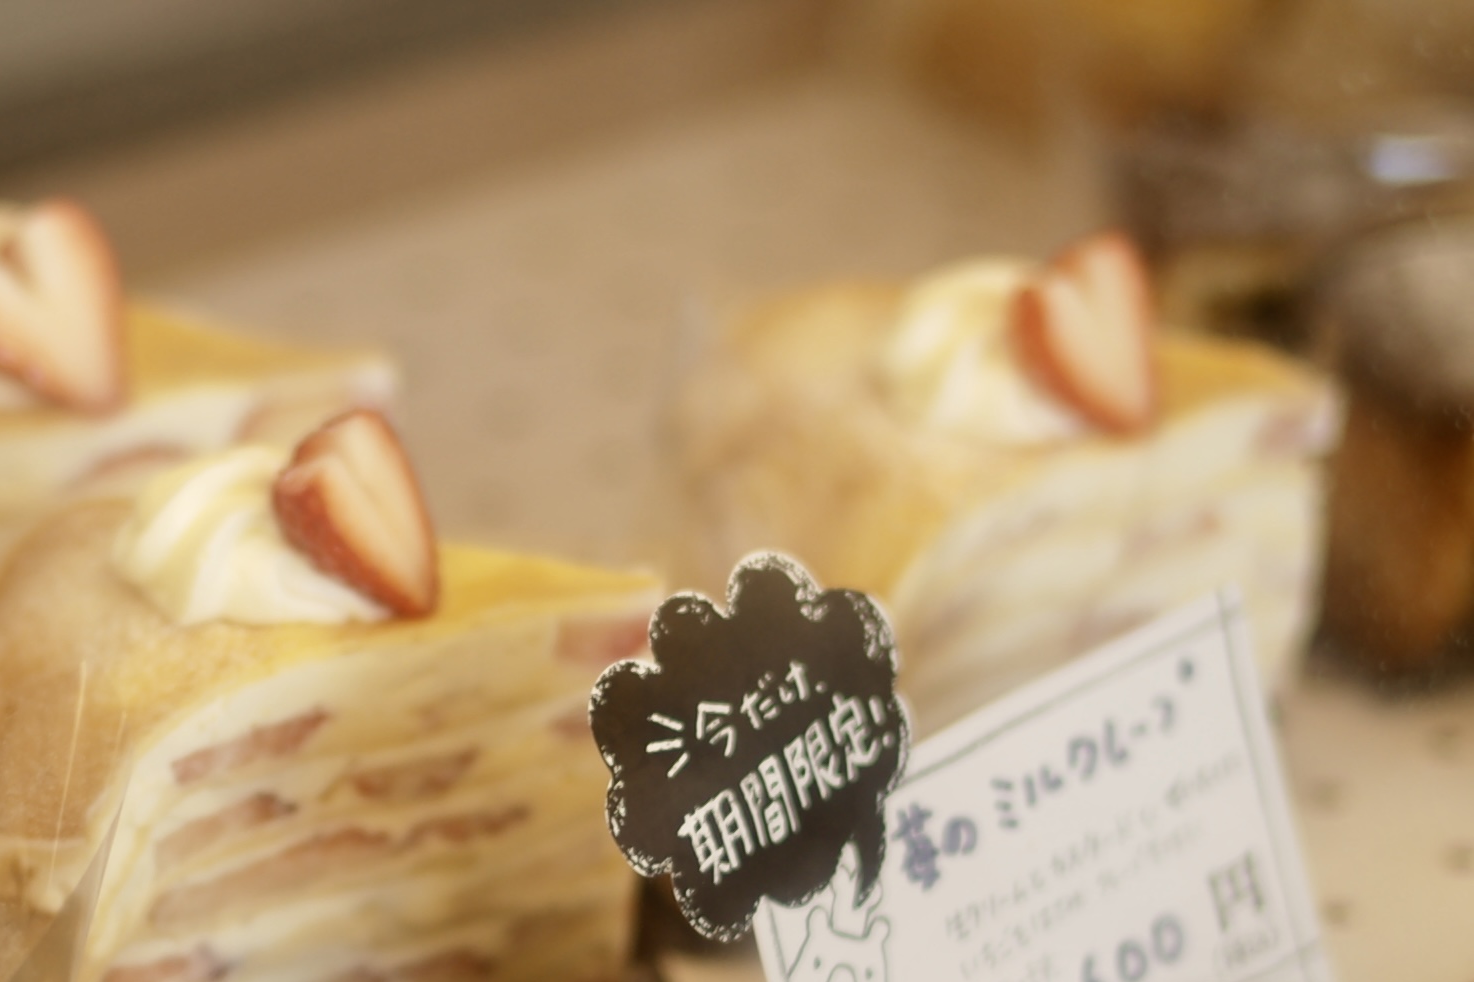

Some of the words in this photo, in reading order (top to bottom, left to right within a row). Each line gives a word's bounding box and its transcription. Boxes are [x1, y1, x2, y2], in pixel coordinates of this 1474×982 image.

[677, 691, 893, 885] 期間限定!
[1207, 850, 1267, 934] 円
